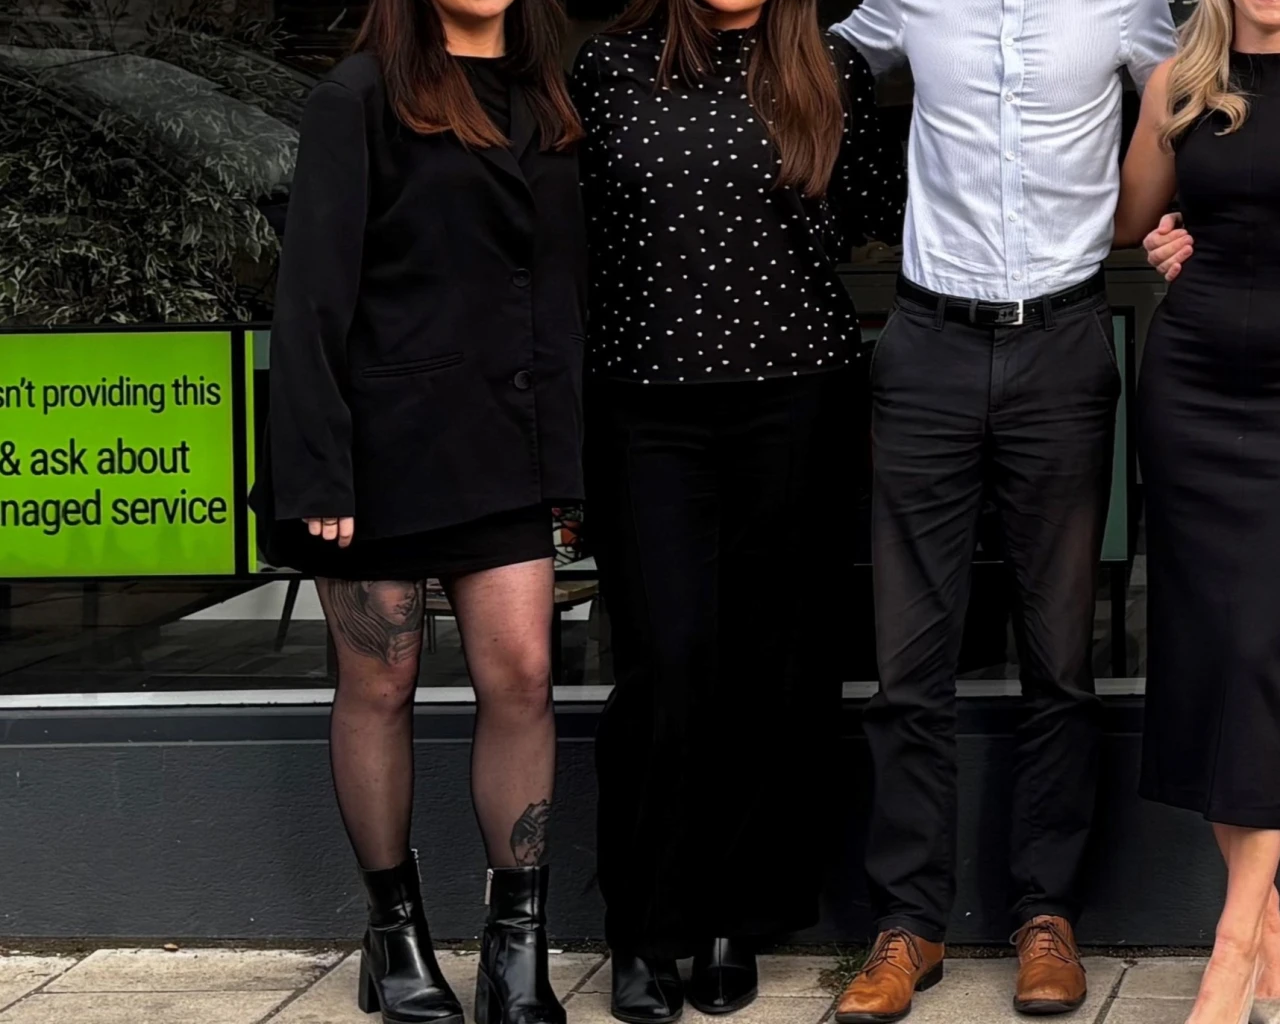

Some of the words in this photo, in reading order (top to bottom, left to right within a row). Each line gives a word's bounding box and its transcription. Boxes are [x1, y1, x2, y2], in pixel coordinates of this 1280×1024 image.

[43, 375, 165, 415] providing
[172, 374, 222, 406] this
[0, 440, 21, 475] &
[30, 437, 88, 475] ask
[97, 437, 190, 474] about
[111, 488, 227, 525] service
